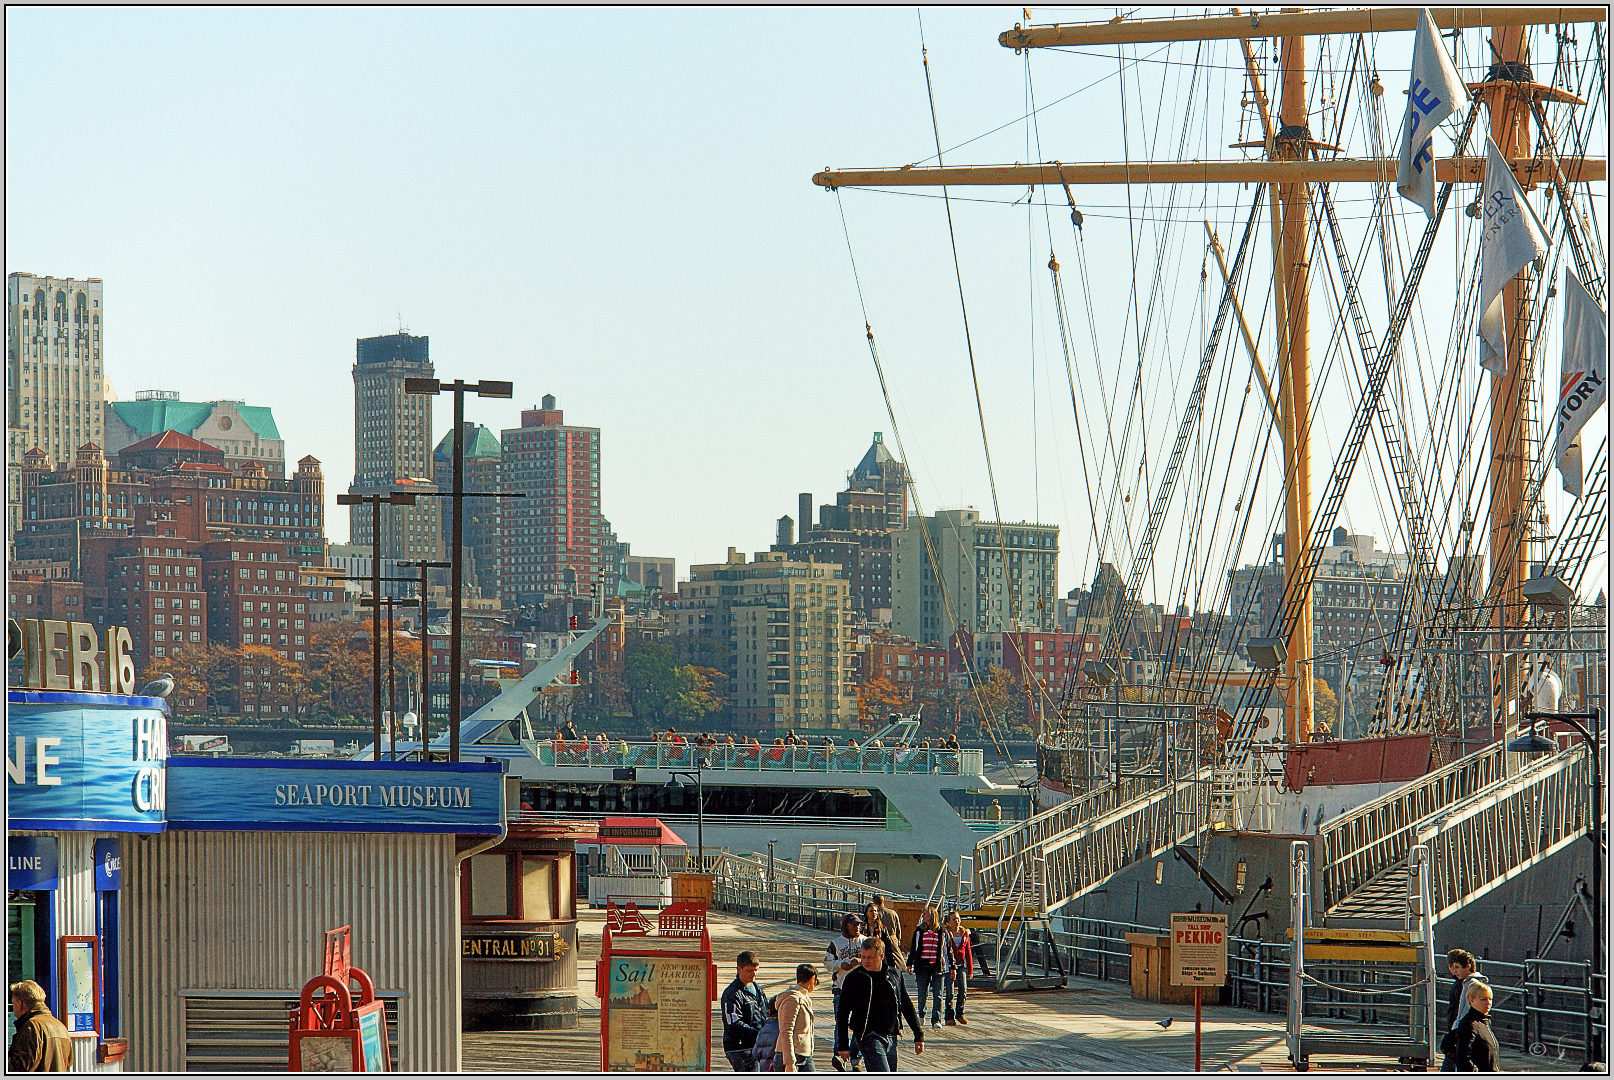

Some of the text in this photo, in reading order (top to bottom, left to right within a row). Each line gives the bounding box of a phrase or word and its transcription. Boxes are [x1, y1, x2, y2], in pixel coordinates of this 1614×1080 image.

[105, 625, 136, 696] 16
[275, 784, 472, 808] SEAPORT MUSEUM
[611, 828, 658, 836] INFORMATION
[10, 856, 42, 870] LINE
[1176, 931, 1223, 944] PEKING
[462, 939, 518, 956] ENTRAL
[538, 940, 549, 956] 31
[615, 963, 656, 983] Sail
[660, 963, 702, 971] NEW YORK
[660, 971, 701, 979] HARBOR
